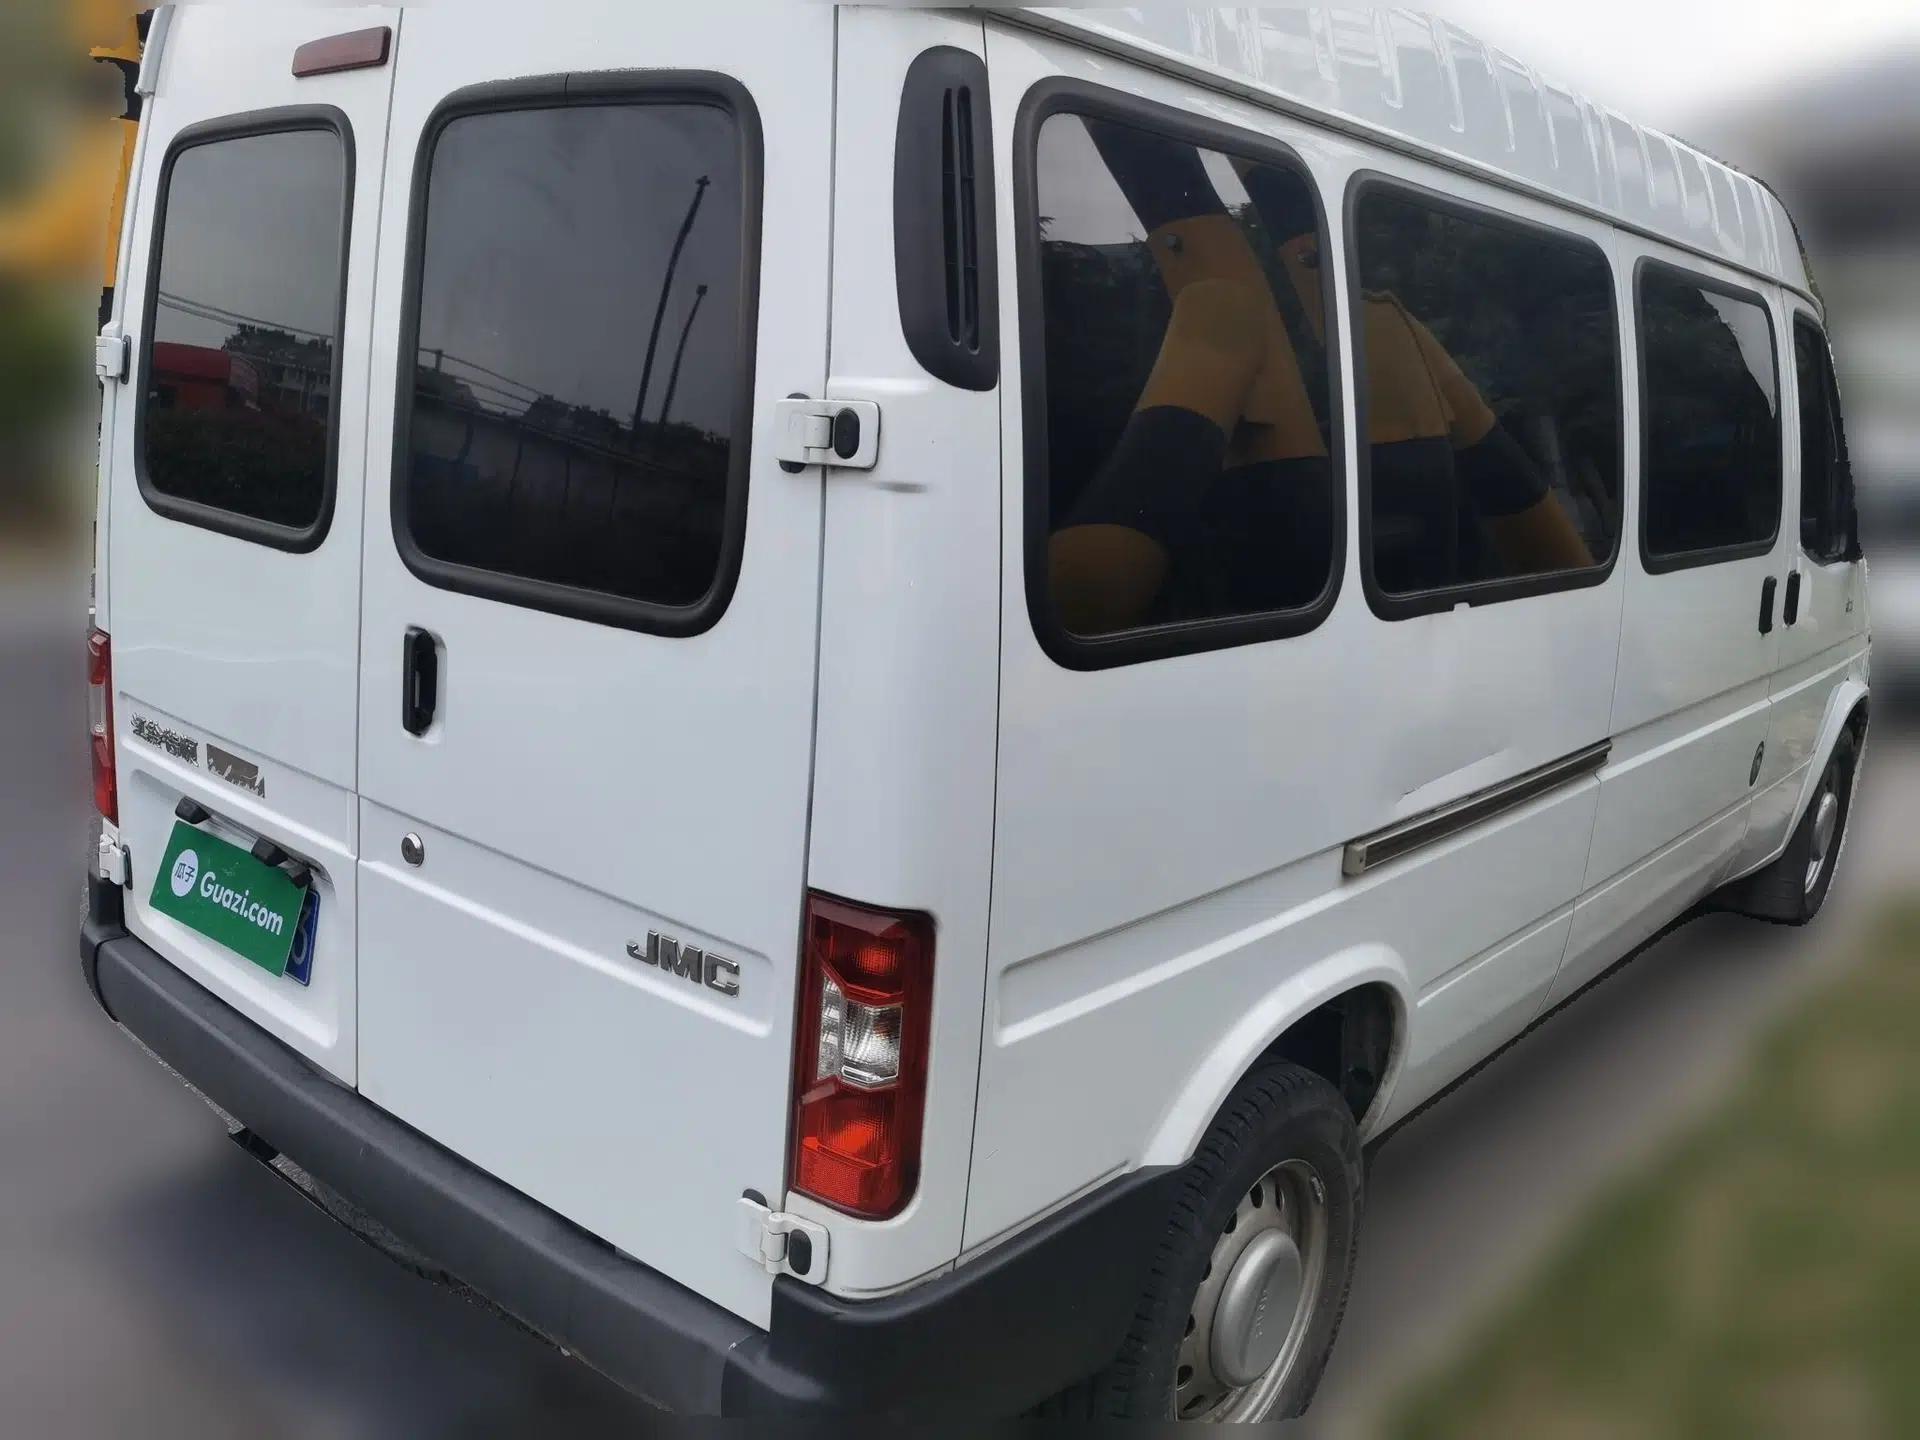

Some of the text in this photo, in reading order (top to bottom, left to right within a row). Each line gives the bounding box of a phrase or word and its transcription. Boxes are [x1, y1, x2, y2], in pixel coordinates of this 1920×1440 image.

[174, 862, 196, 883] 瓜子
[200, 871, 284, 936] Guazi.com
[626, 929, 741, 998] JMC
